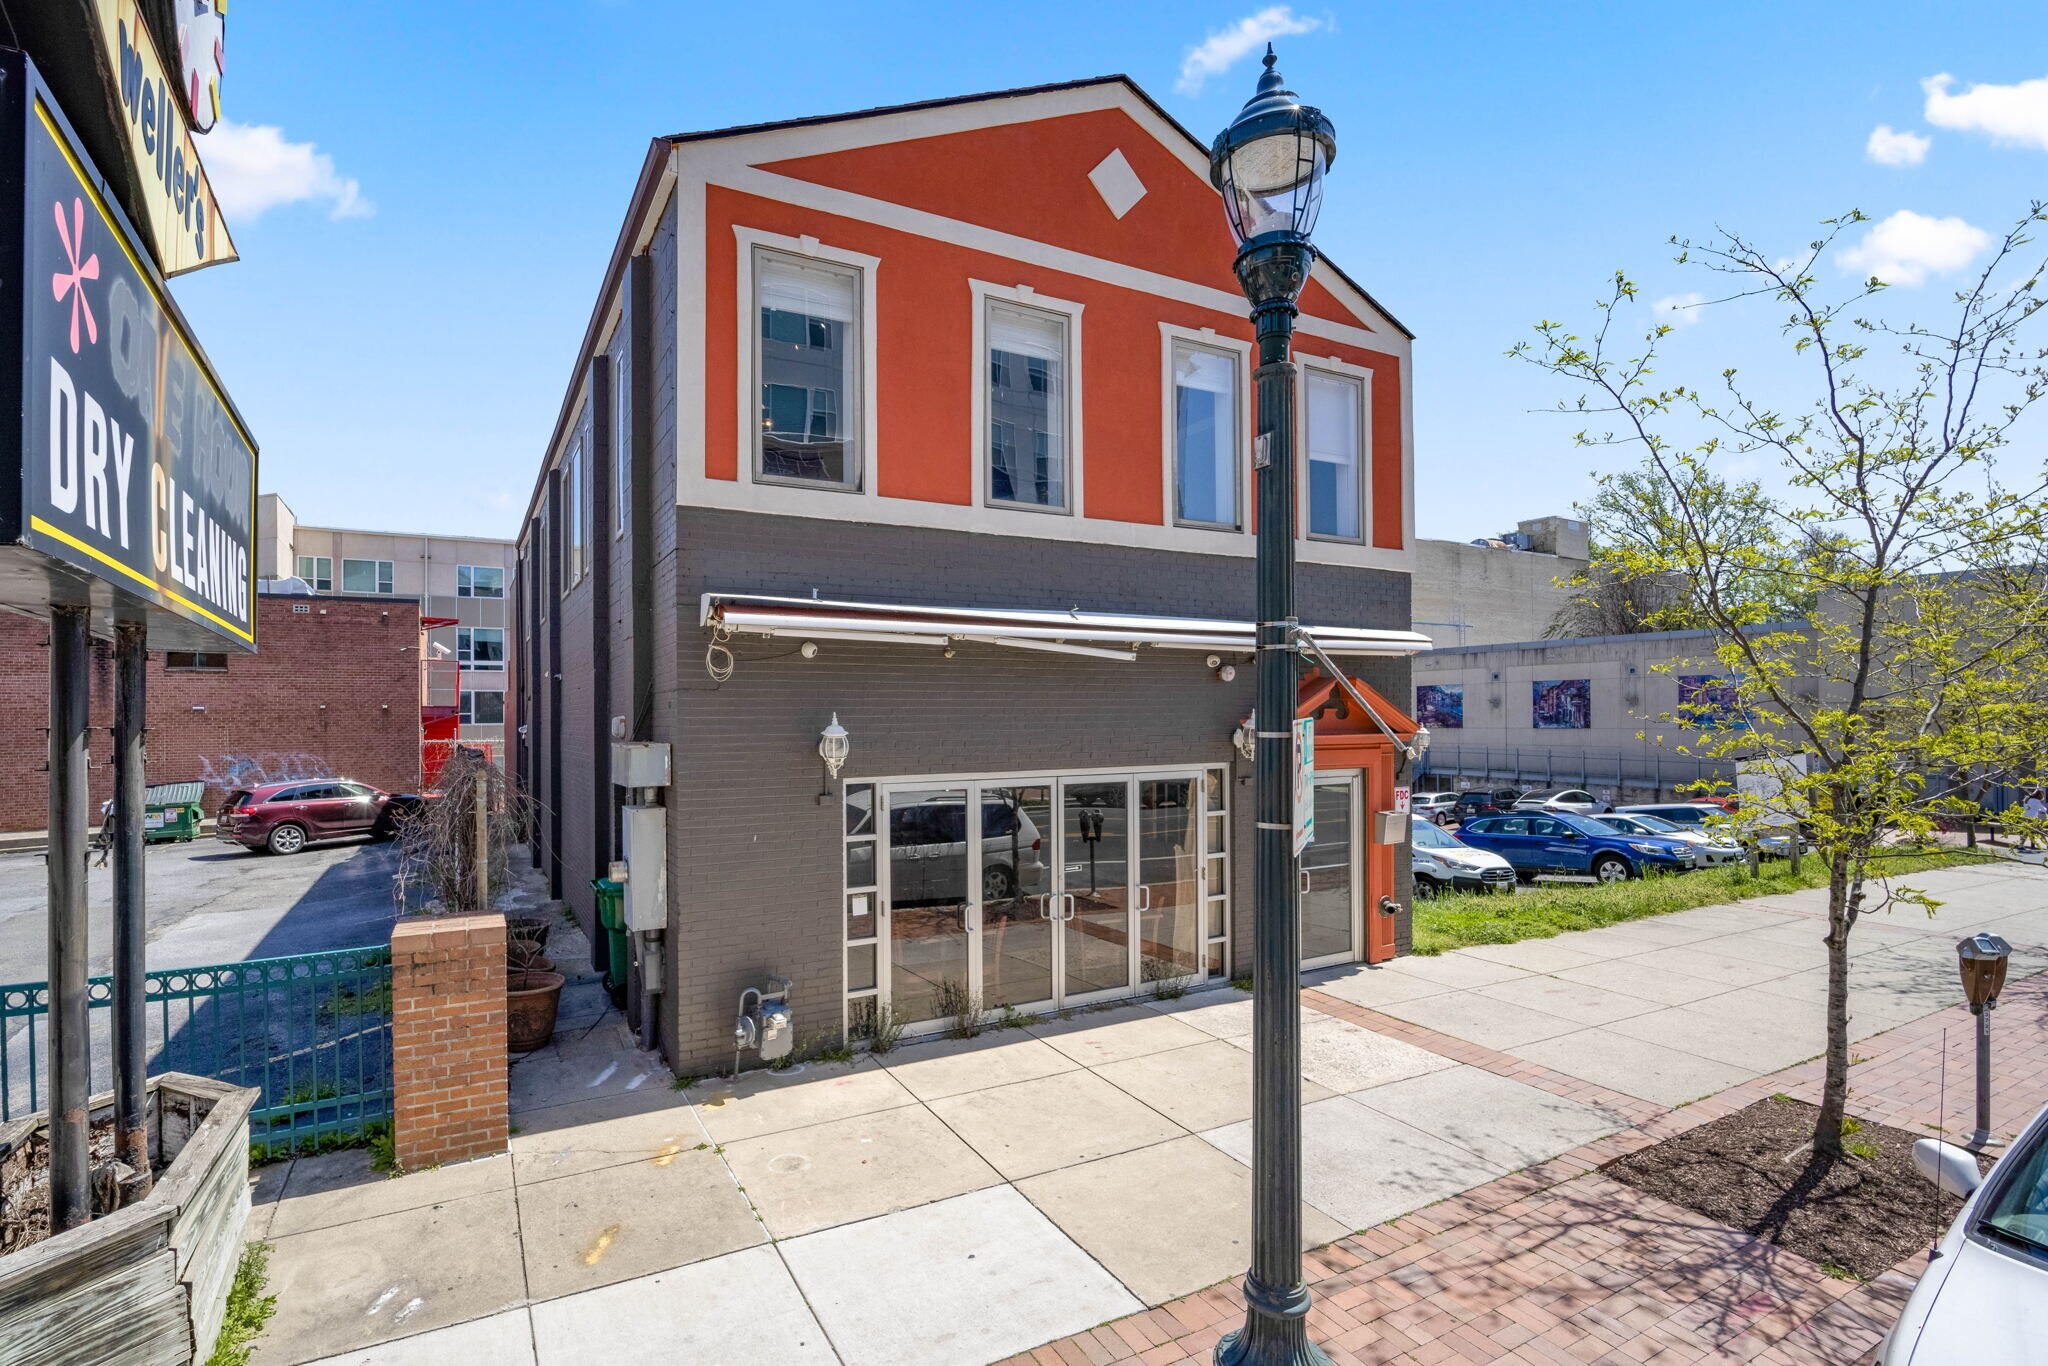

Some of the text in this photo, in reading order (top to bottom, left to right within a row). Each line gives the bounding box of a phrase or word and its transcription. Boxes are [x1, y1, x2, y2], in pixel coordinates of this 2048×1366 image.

[49, 355, 248, 624] DRY CLEANING
[1395, 790, 1409, 800] FDC
